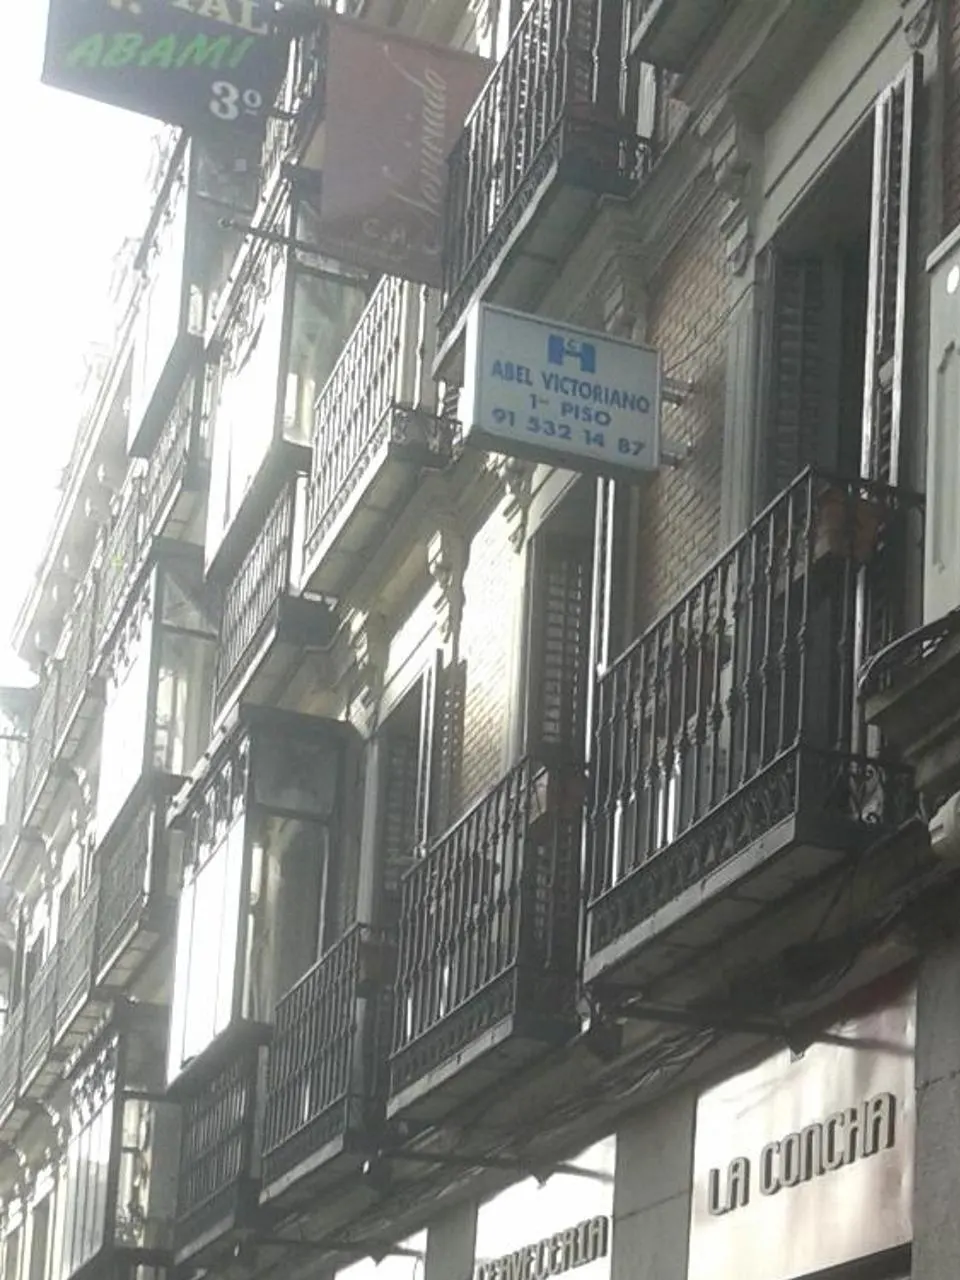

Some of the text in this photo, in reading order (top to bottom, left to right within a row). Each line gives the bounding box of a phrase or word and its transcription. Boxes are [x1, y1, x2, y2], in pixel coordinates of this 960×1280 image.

[64, 32, 255, 69] ABAMI
[491, 360, 650, 414] ABEL VICTORIANO
[491, 408, 645, 456] 91 532 14 87
[561, 402, 612, 426] PISO
[708, 1092, 896, 1216] LA CONCHA
